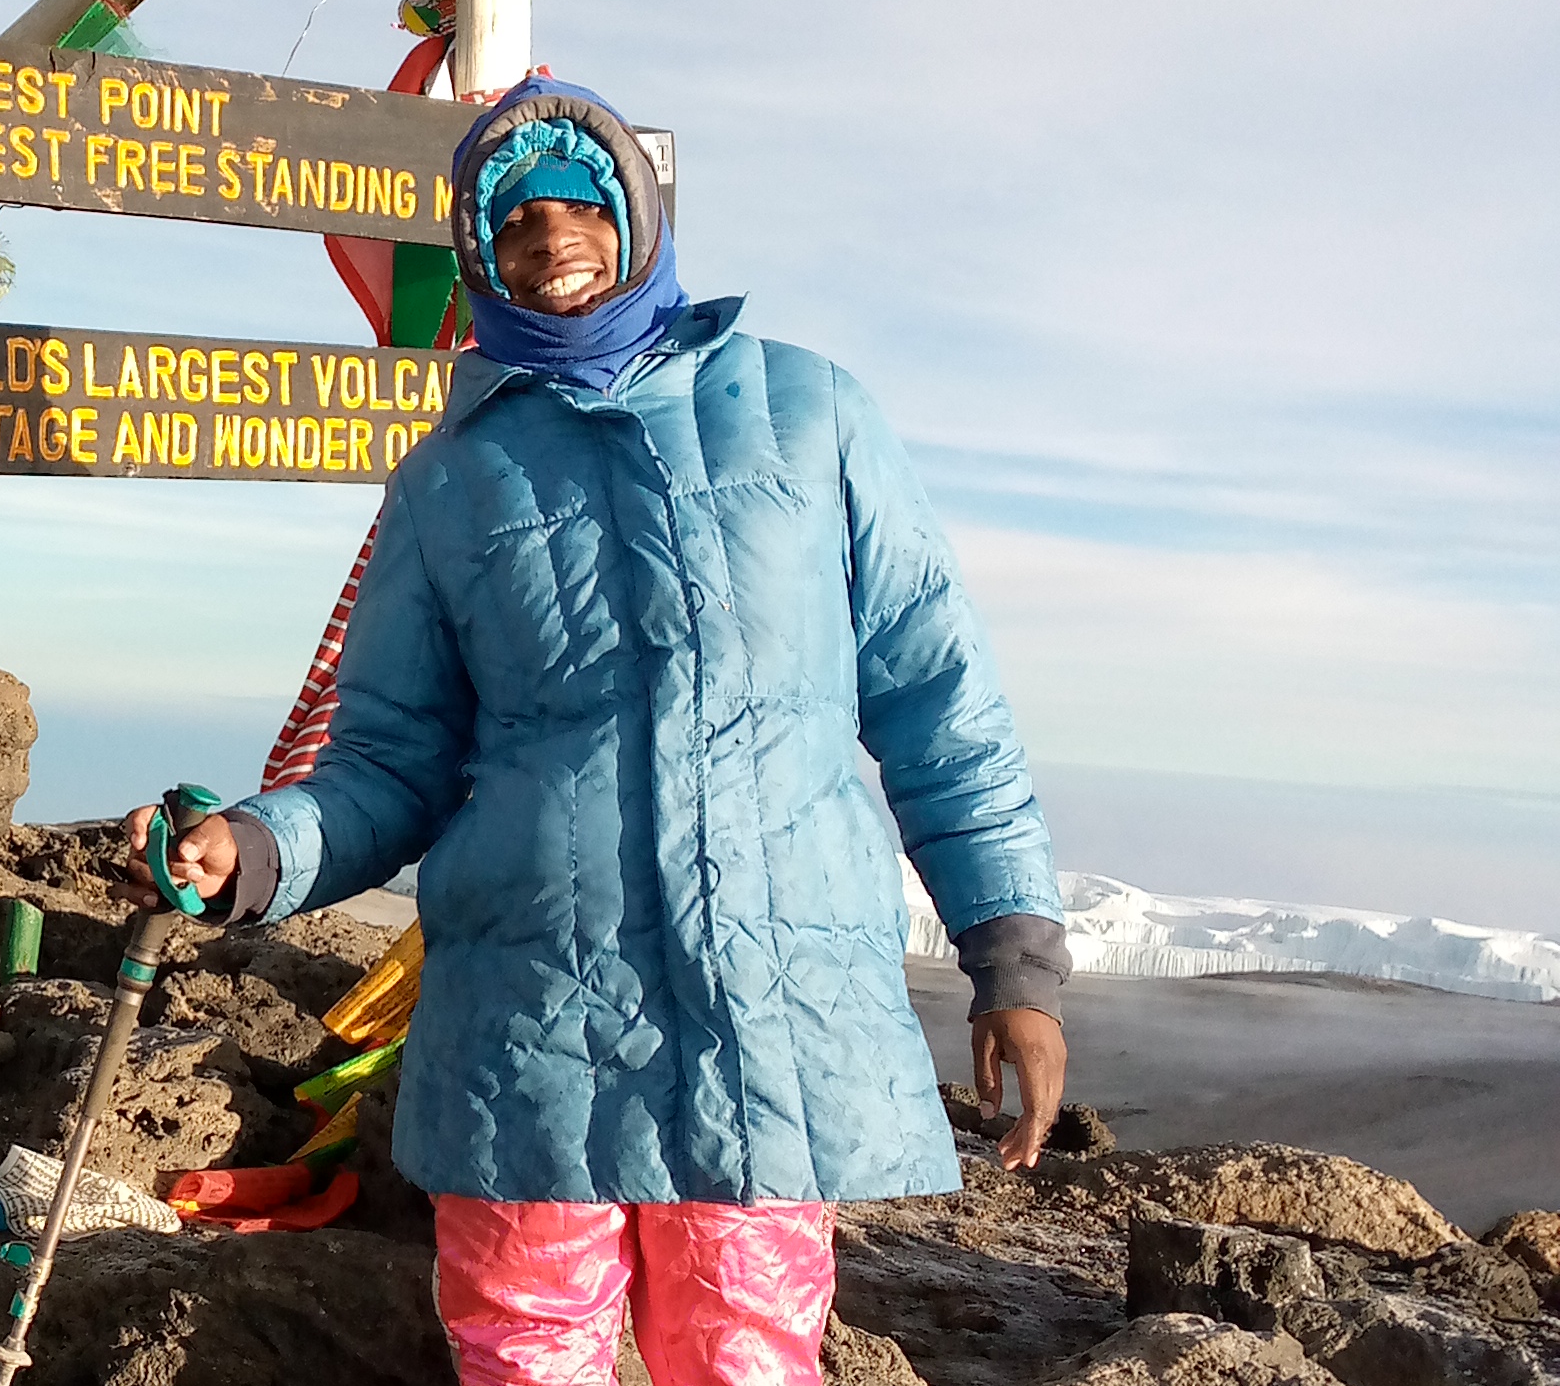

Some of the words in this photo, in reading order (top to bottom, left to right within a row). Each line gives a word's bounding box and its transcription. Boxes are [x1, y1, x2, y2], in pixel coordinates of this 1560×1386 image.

[100, 75, 232, 138] POINT
[85, 133, 207, 197] FREE
[216, 144, 417, 220] STANDING
[83, 343, 297, 409] LARGEST
[112, 411, 197, 469] AND
[212, 415, 373, 473] WONDER
